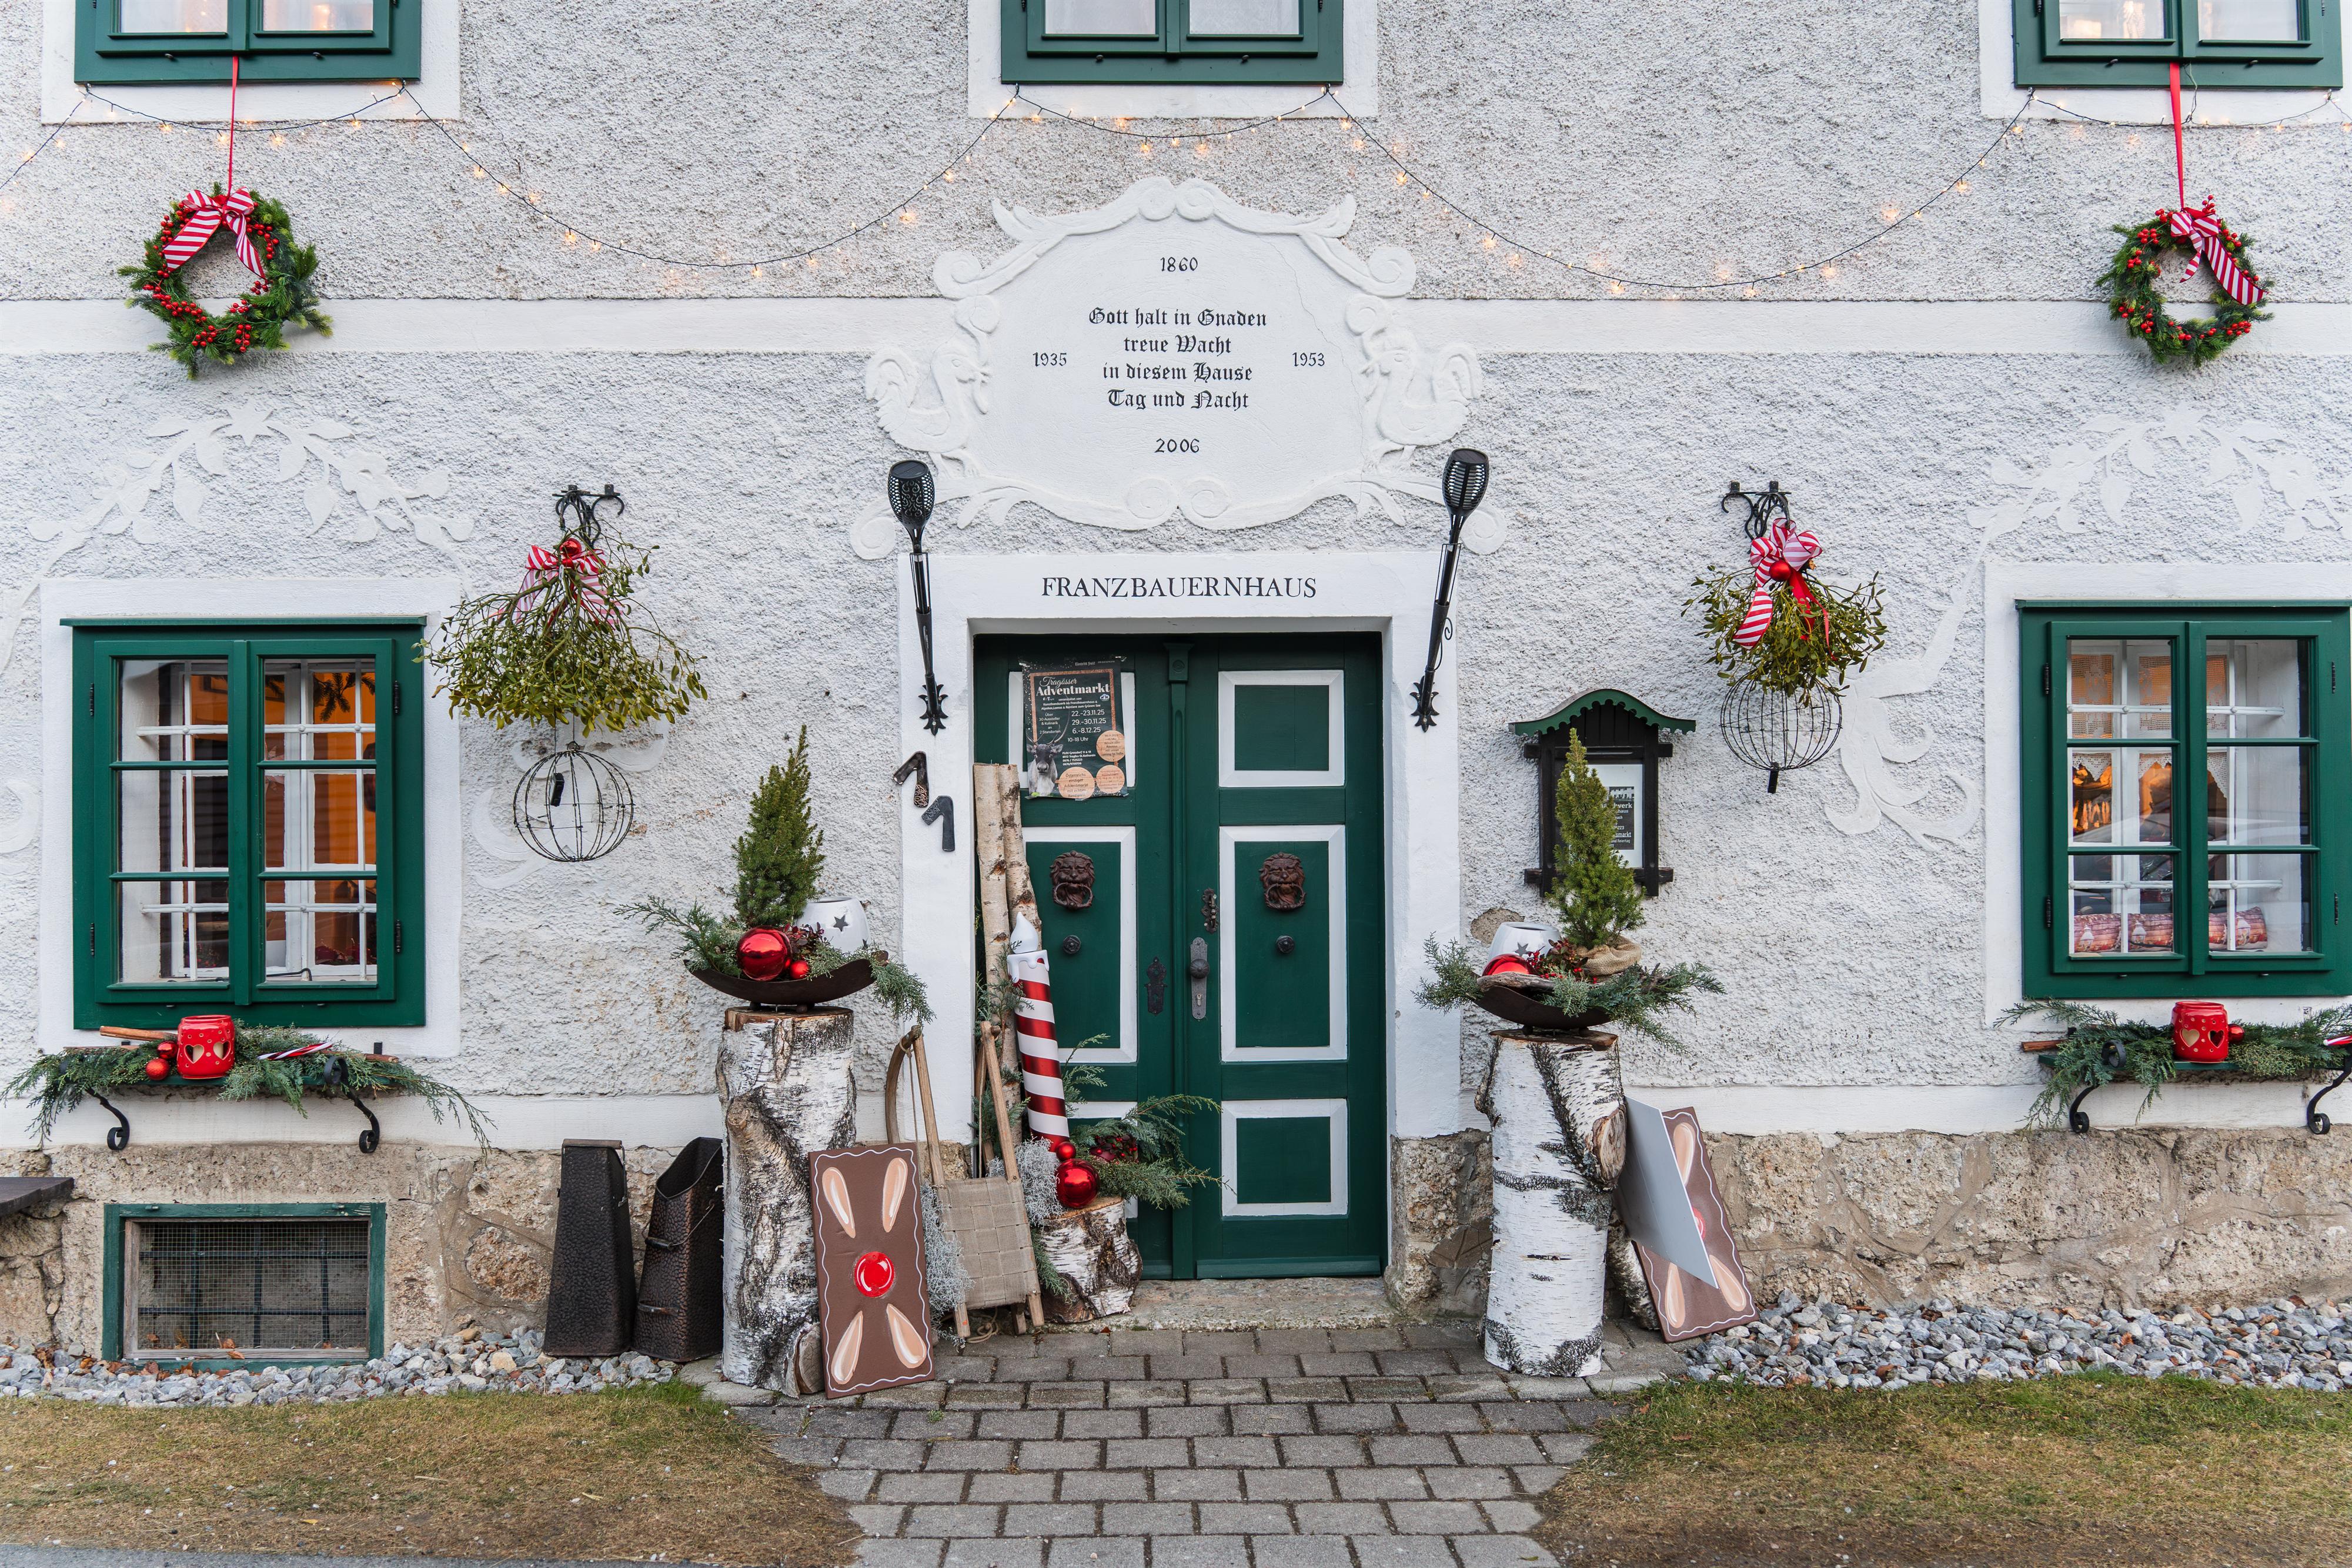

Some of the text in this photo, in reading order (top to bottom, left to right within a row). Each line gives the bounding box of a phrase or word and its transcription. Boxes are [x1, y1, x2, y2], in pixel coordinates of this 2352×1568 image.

[1161, 257, 1198, 272] 1860
[1090, 307, 1266, 326] Gott halt in Gnaden
[1124, 335, 1231, 356] treue Wacht
[1033, 352, 1067, 367] 1935
[1293, 352, 1324, 367] 1953
[1104, 363, 1252, 383] in diesem Hause
[1108, 389, 1248, 411] Tag und Nacht
[1155, 438, 1199, 453] 2006
[1041, 577, 1316, 598] FRANZBAUERNHAUS
[1036, 683, 1110, 696] Adventmarkt
[1039, 676, 1077, 688] Tragösser
